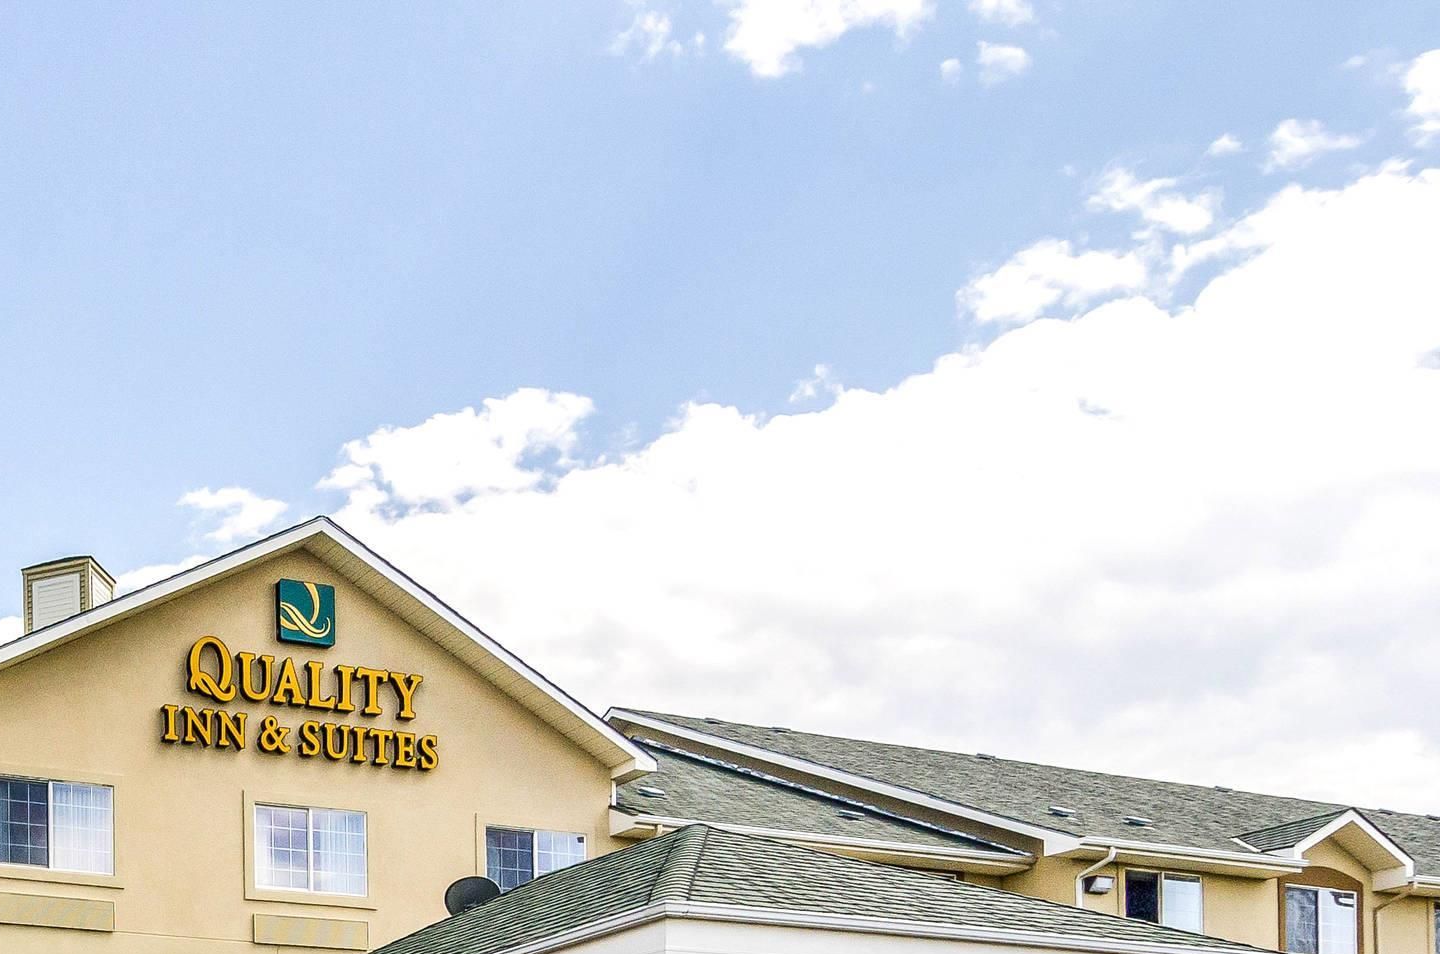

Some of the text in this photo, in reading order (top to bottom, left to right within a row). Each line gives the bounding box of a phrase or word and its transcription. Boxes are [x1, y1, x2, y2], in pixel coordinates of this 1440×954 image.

[187, 635, 424, 720] QUALITY
[161, 704, 440, 770] INN & SUITES
